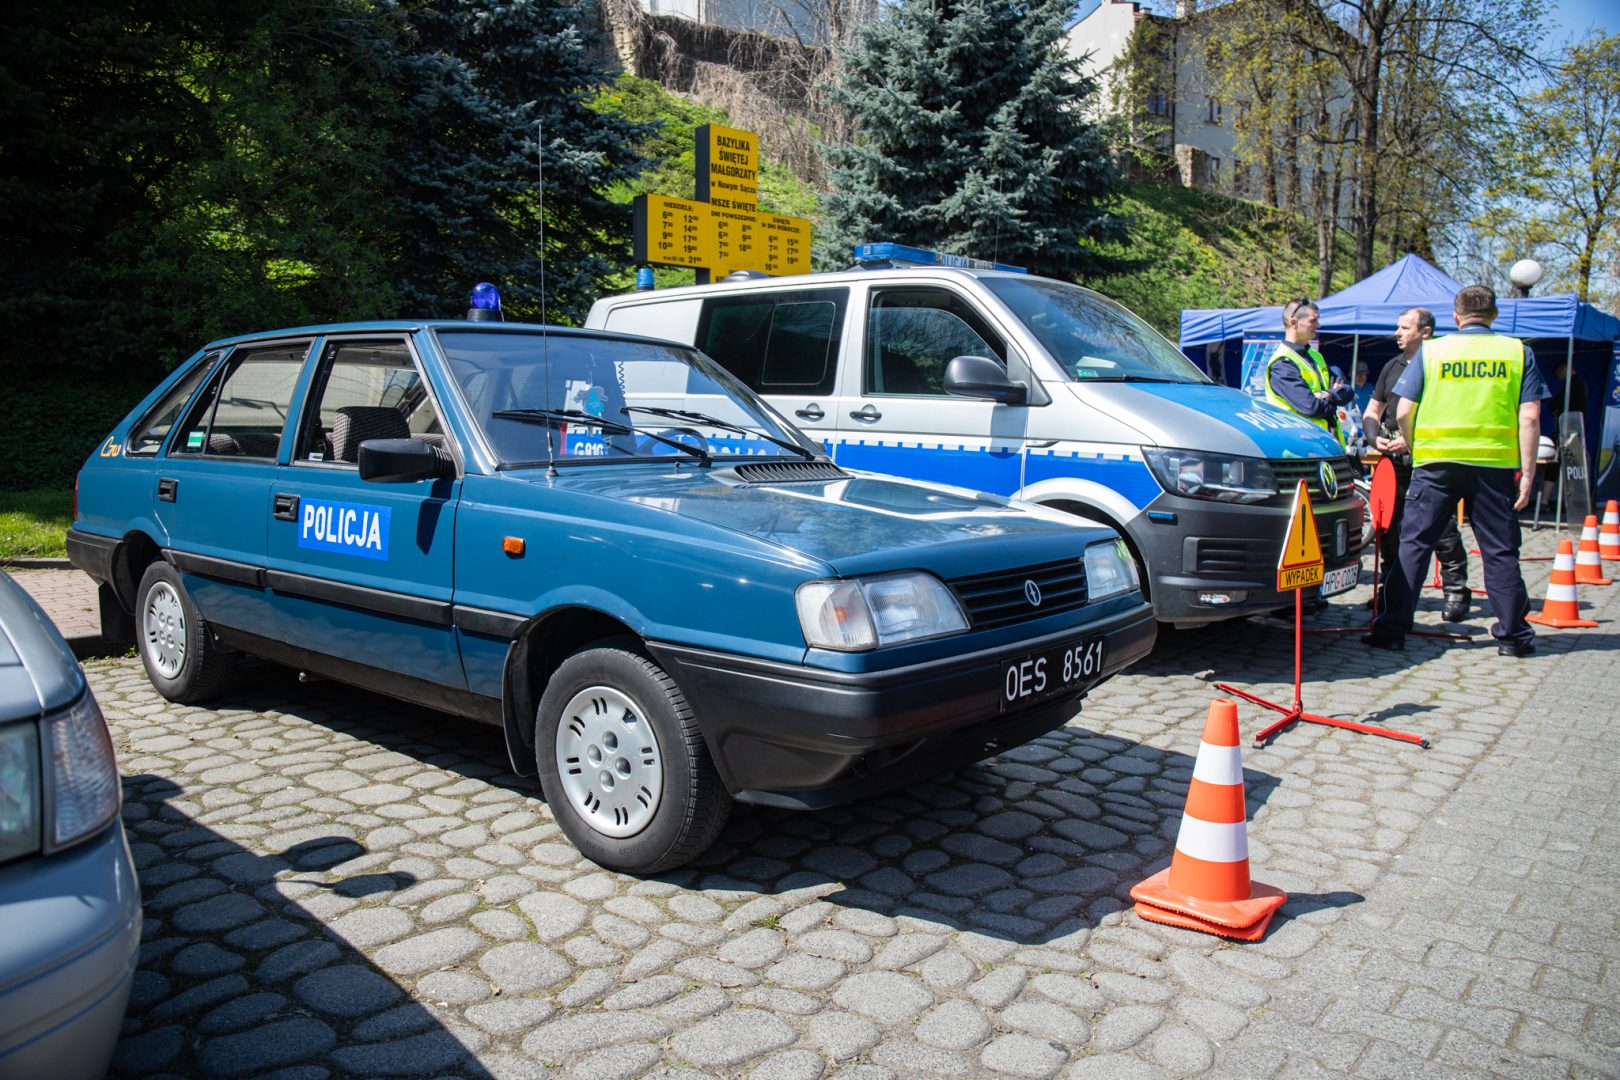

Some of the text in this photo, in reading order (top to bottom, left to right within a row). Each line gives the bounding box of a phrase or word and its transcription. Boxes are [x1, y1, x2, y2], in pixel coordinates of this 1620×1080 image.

[717, 135, 750, 152] BAZYLIKA
[719, 147, 749, 166] ŚWIĘTEJ
[711, 163, 756, 181] MAŁGORZATY
[718, 180, 738, 191] Nowym
[711, 197, 757, 213] MSZE ŚWIĘTE
[1441, 361, 1507, 378] POLICJA
[302, 504, 382, 550] POLICJA
[1285, 568, 1319, 586] WYPADEK
[1006, 641, 1103, 701] OES 8561
